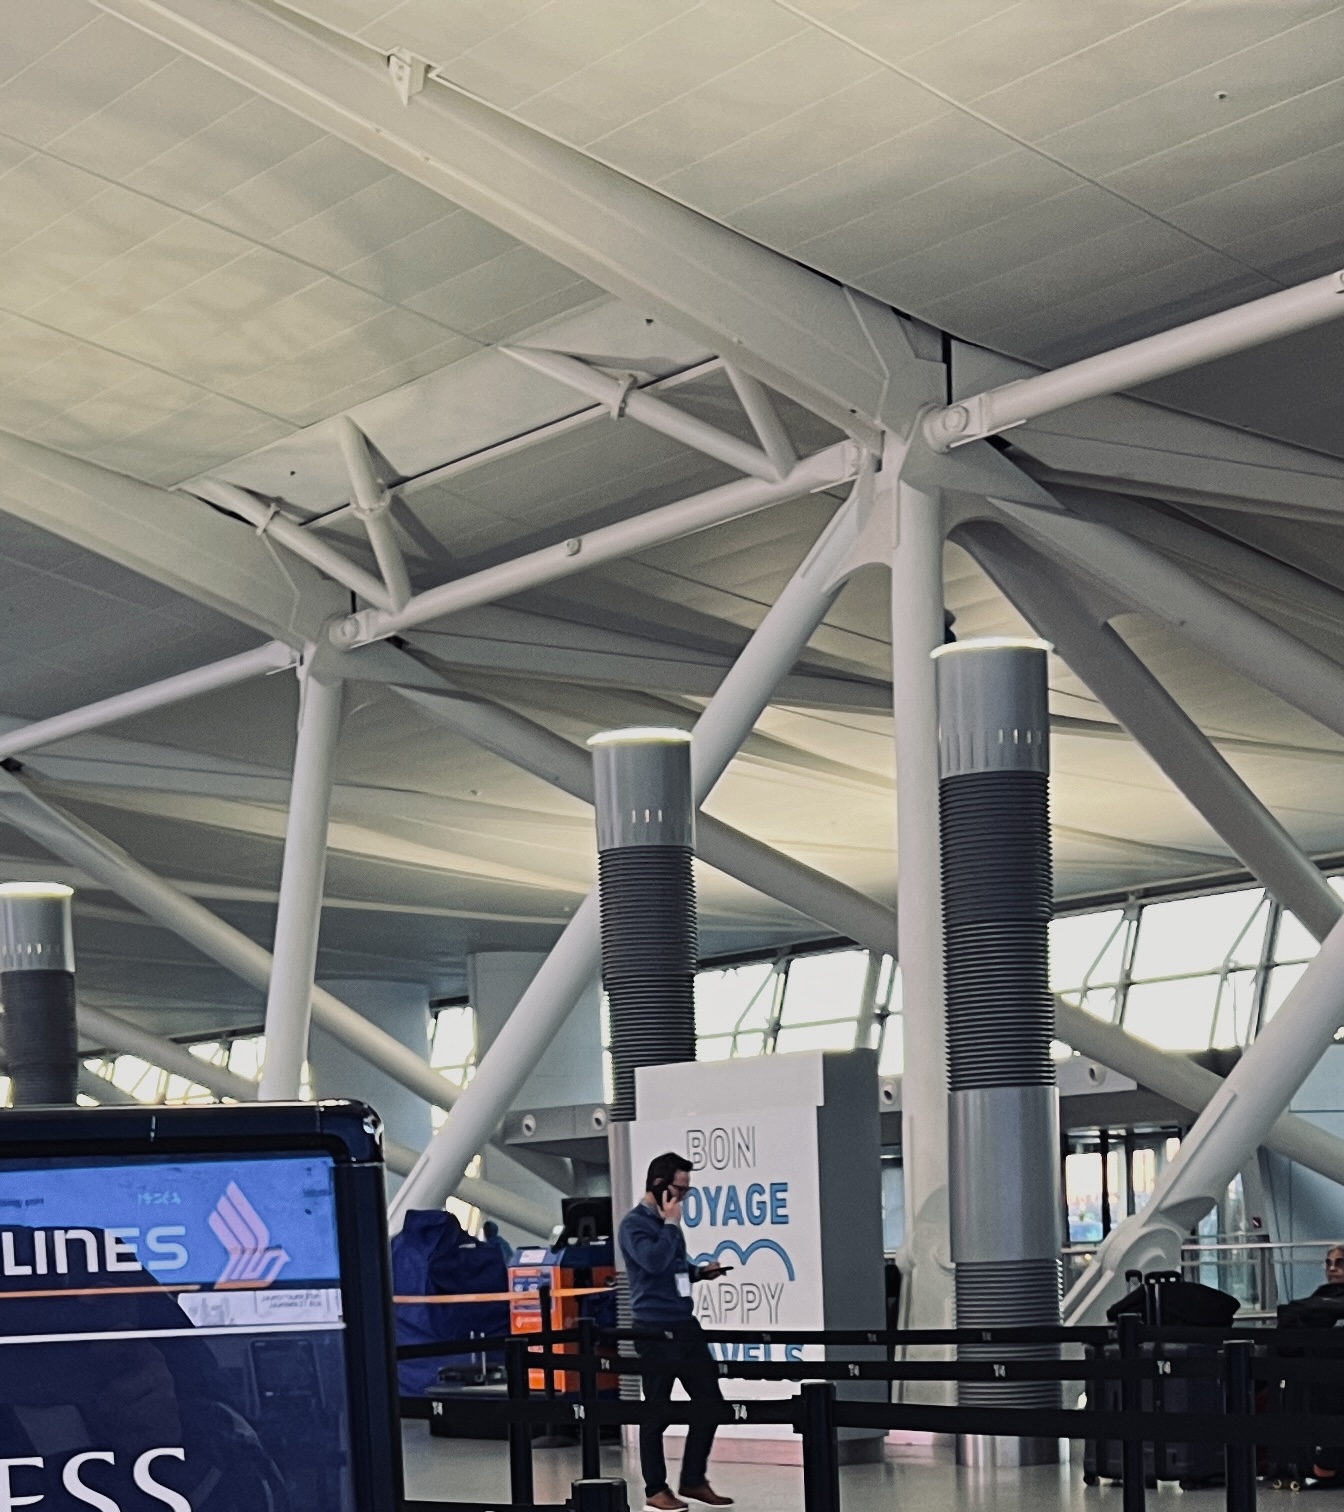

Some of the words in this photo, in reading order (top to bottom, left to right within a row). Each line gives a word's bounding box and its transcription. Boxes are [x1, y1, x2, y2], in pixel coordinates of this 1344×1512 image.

[685, 1125, 757, 1172] BON
[682, 1182, 789, 1228] OYAGE
[697, 1282, 785, 1325] APPY
